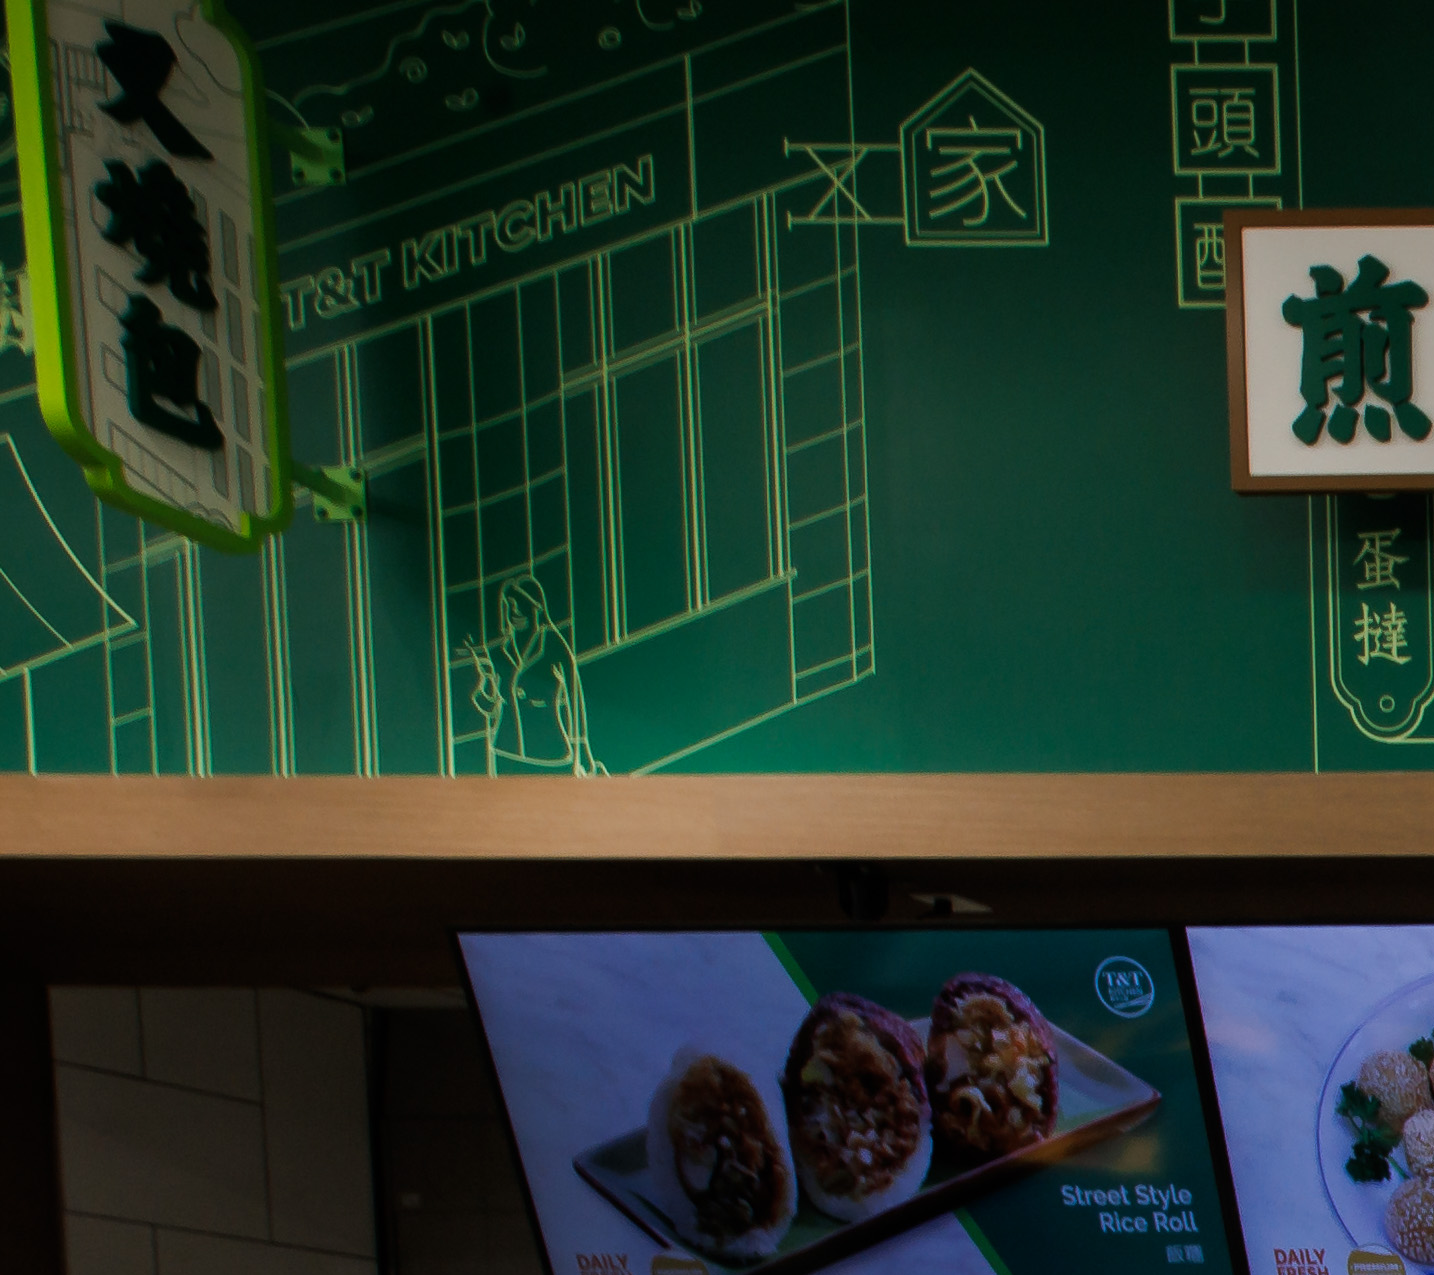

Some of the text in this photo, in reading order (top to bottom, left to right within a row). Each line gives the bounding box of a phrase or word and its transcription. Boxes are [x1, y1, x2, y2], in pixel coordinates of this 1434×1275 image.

[926, 116, 1027, 227] 家
[279, 155, 657, 331] T&T KITCHEN
[1352, 528, 1412, 668] 蛋撻
[1102, 970, 1144, 987] T&T
[1061, 1184, 1193, 1210] Street Style
[1100, 1211, 1199, 1233] Rice Roll
[575, 1252, 629, 1271] DAILY
[1273, 1247, 1326, 1265] DAILY
